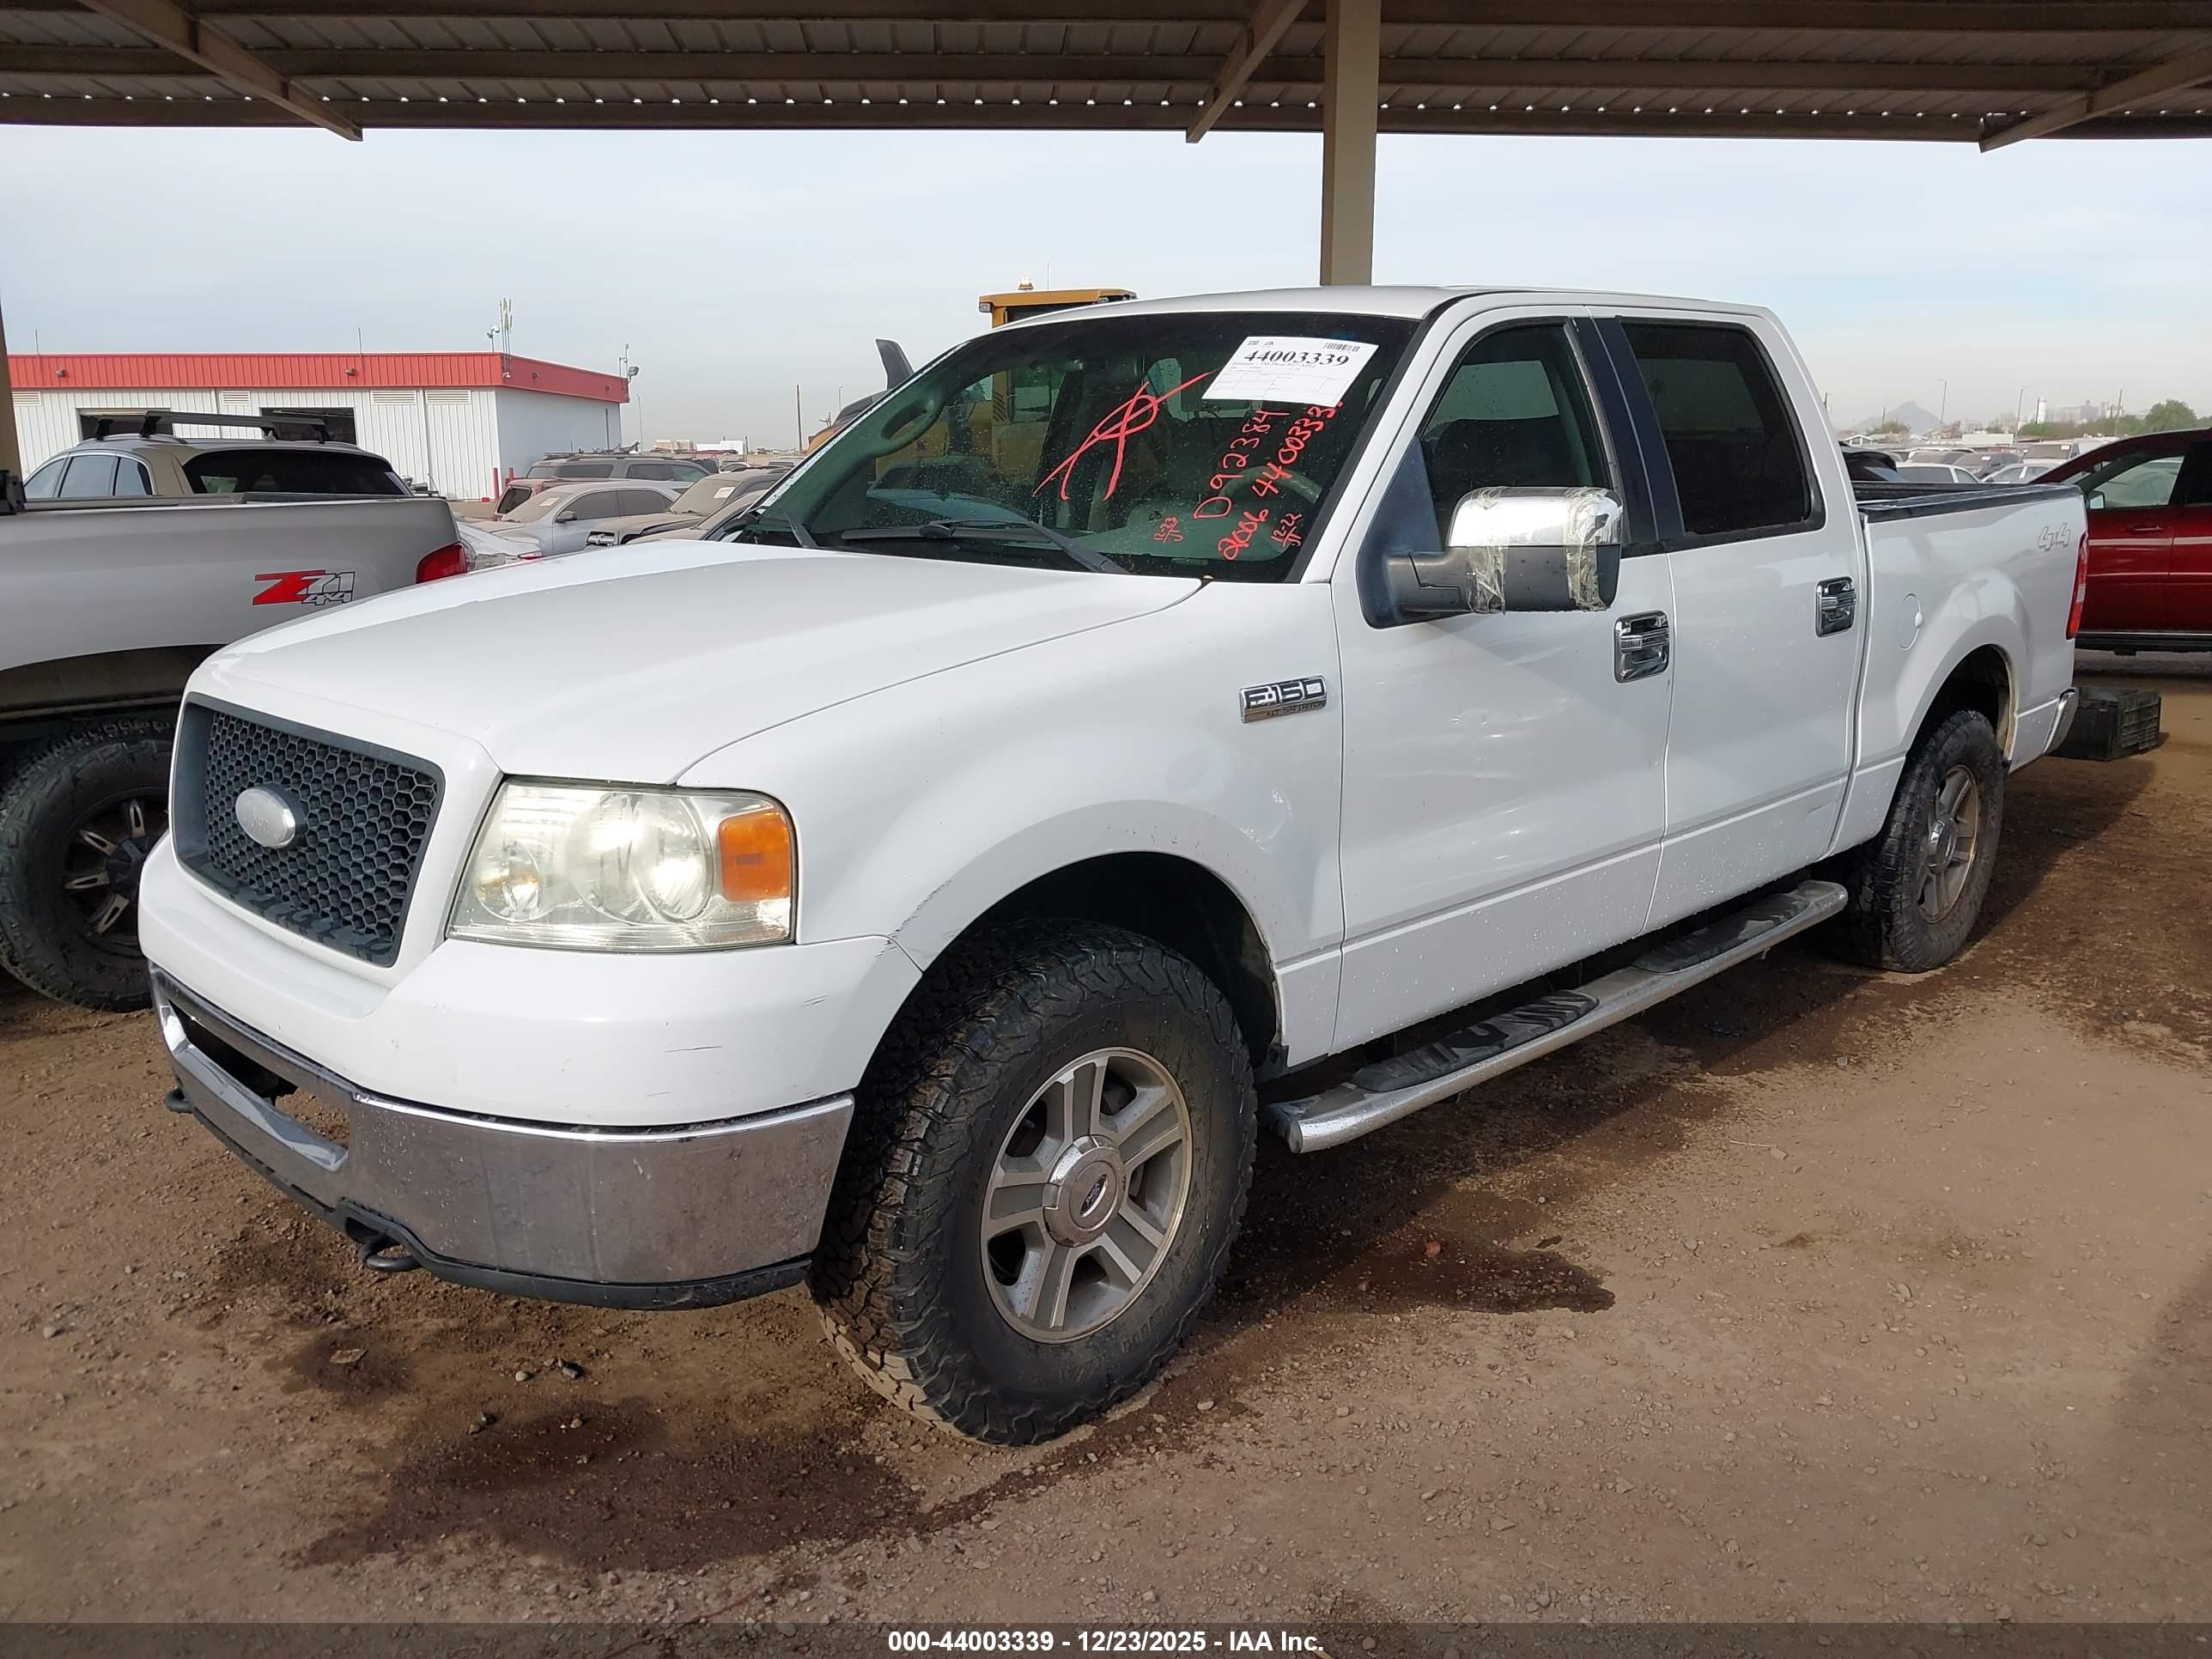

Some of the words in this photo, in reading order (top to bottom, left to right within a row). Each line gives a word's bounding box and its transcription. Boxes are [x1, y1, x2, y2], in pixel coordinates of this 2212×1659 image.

[1244, 349, 1351, 368] 44003339
[1218, 508, 1269, 561] 2006
[1251, 400, 1345, 498] 4400333
[252, 569, 356, 605] Z71
